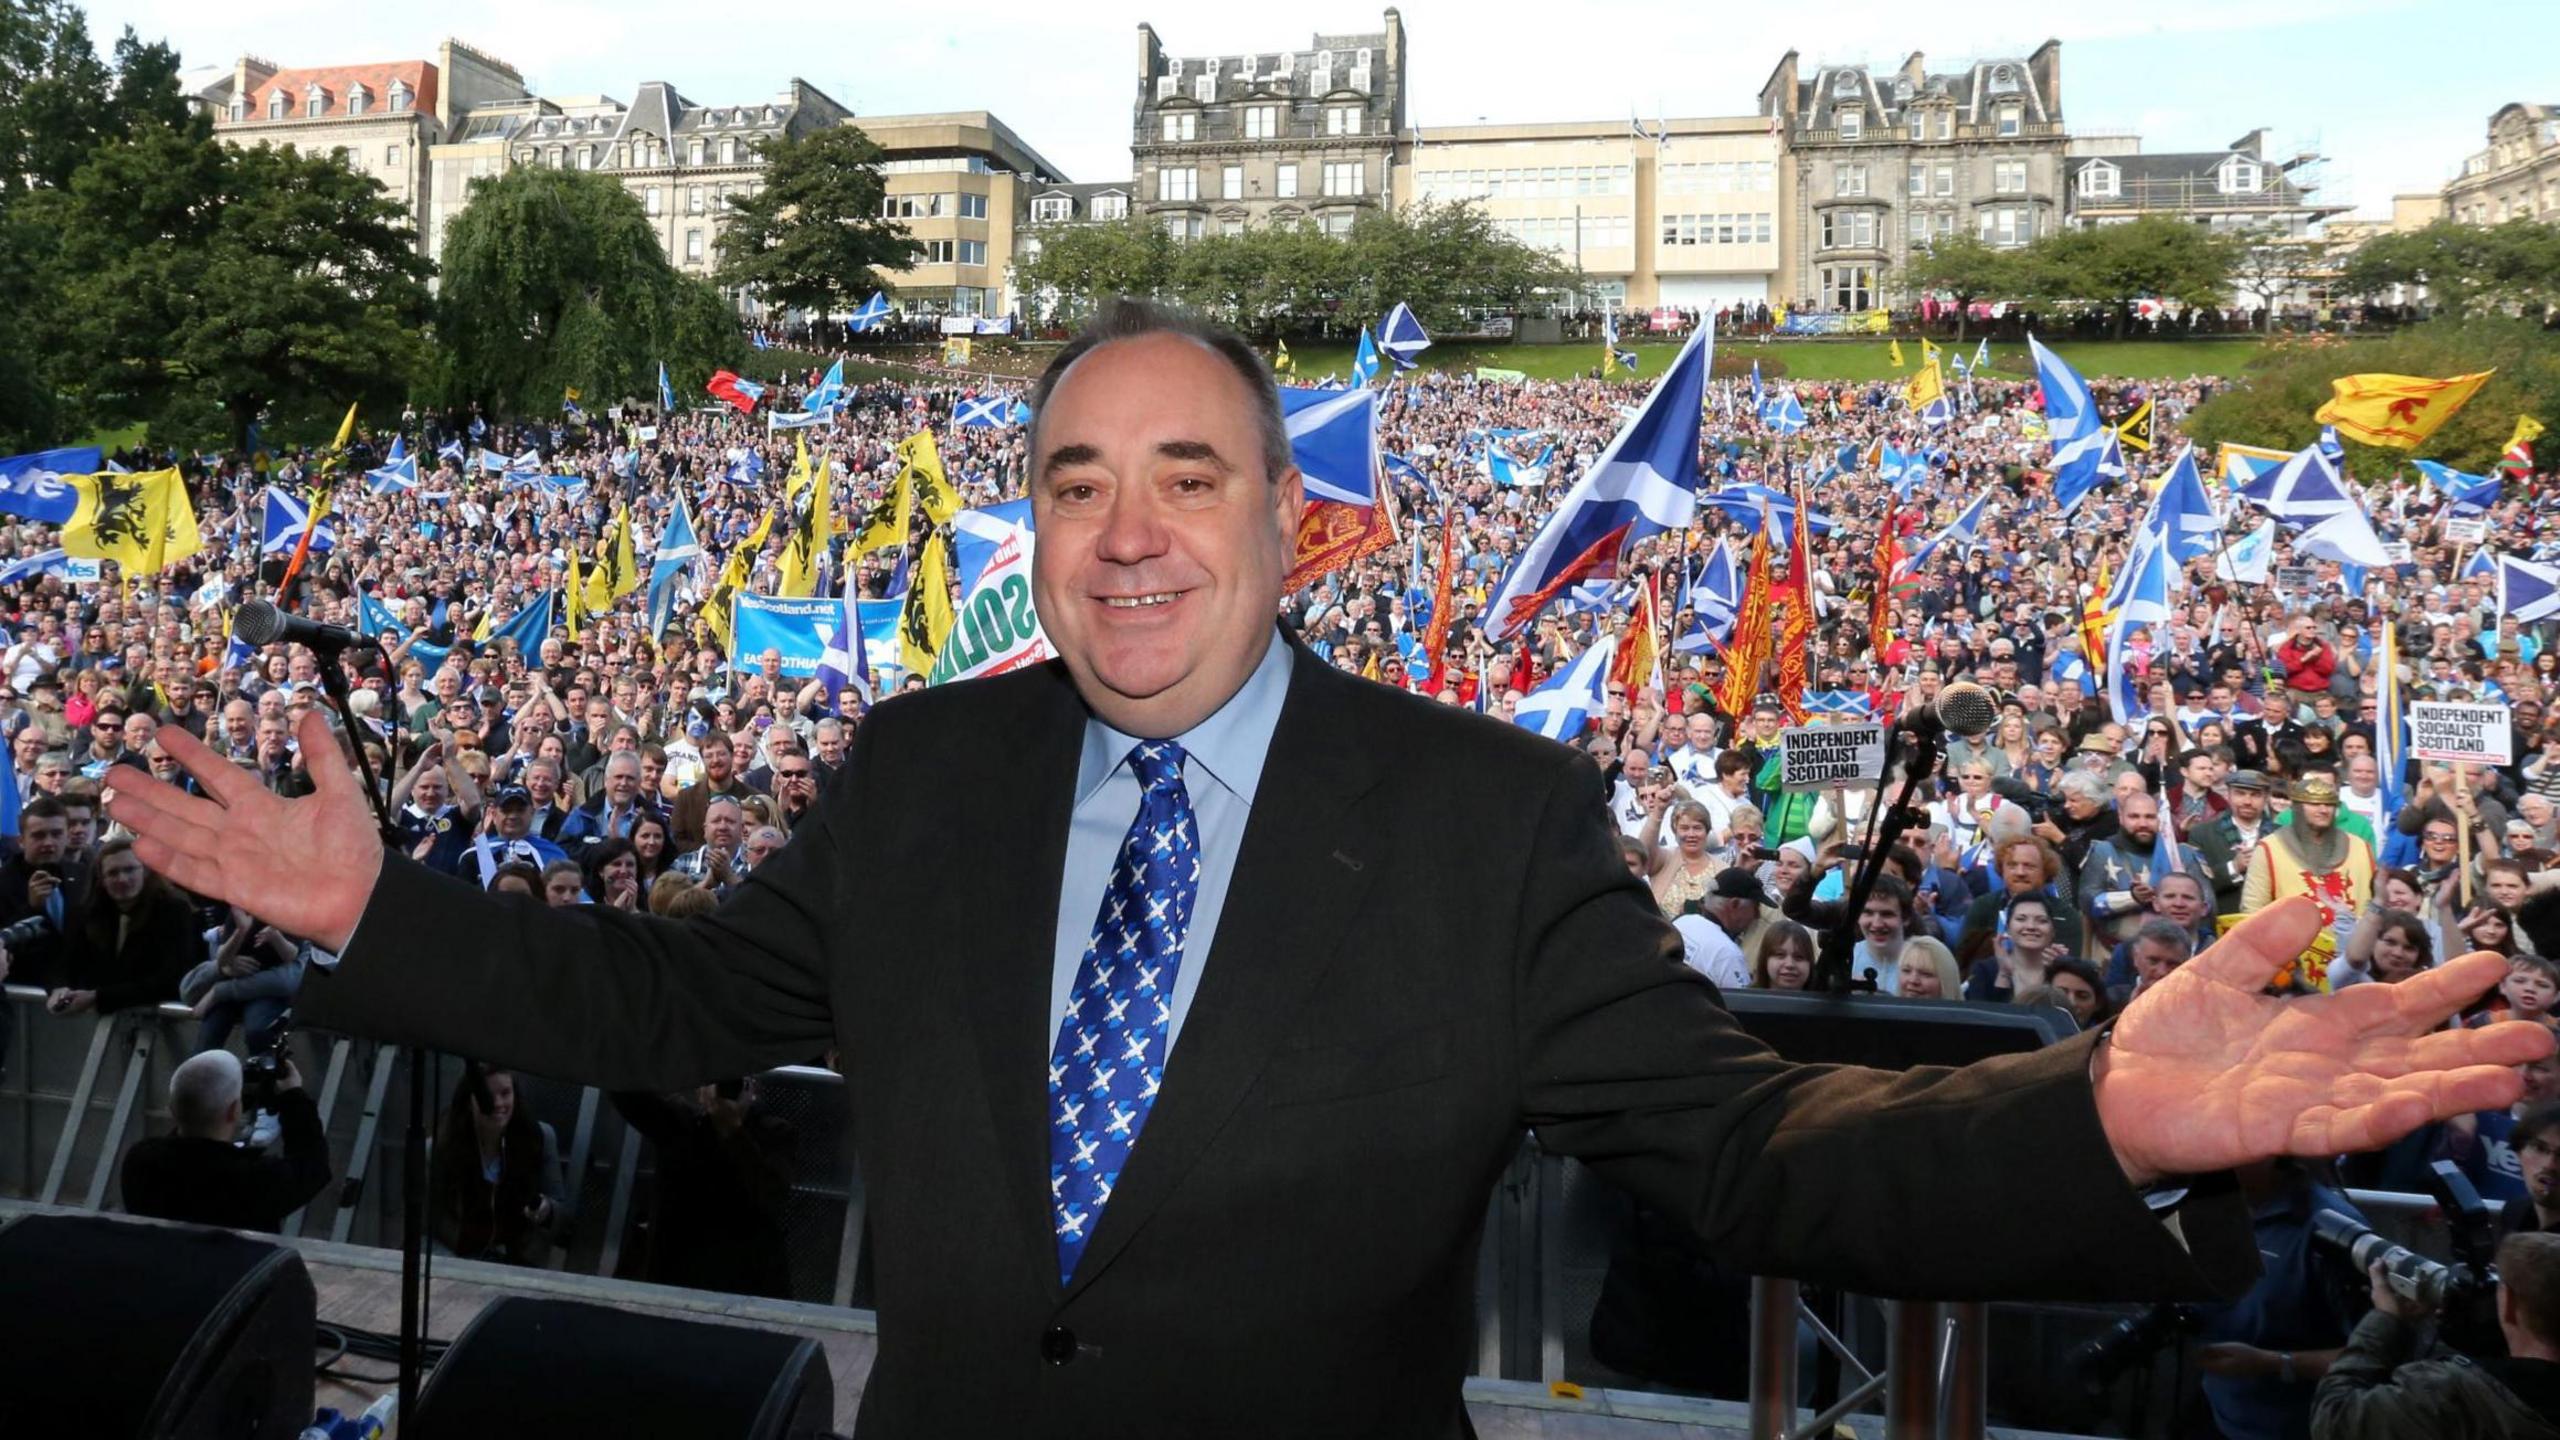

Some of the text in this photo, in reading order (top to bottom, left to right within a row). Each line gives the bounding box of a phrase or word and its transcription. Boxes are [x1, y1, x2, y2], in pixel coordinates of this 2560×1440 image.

[67, 562, 97, 577] Yes
[743, 652, 824, 670] EAS OTHIA
[2416, 707, 2504, 724] INDEPENDENT
[2417, 721, 2483, 738] SOCIALIST
[1786, 730, 1879, 750] INDEPENDENT
[2417, 735, 2485, 753] SCOTLAND
[1787, 747, 1858, 766] SOCIALIST
[1787, 763, 1860, 783] SCOTLAND
[2479, 1134, 2523, 1173] Ye
